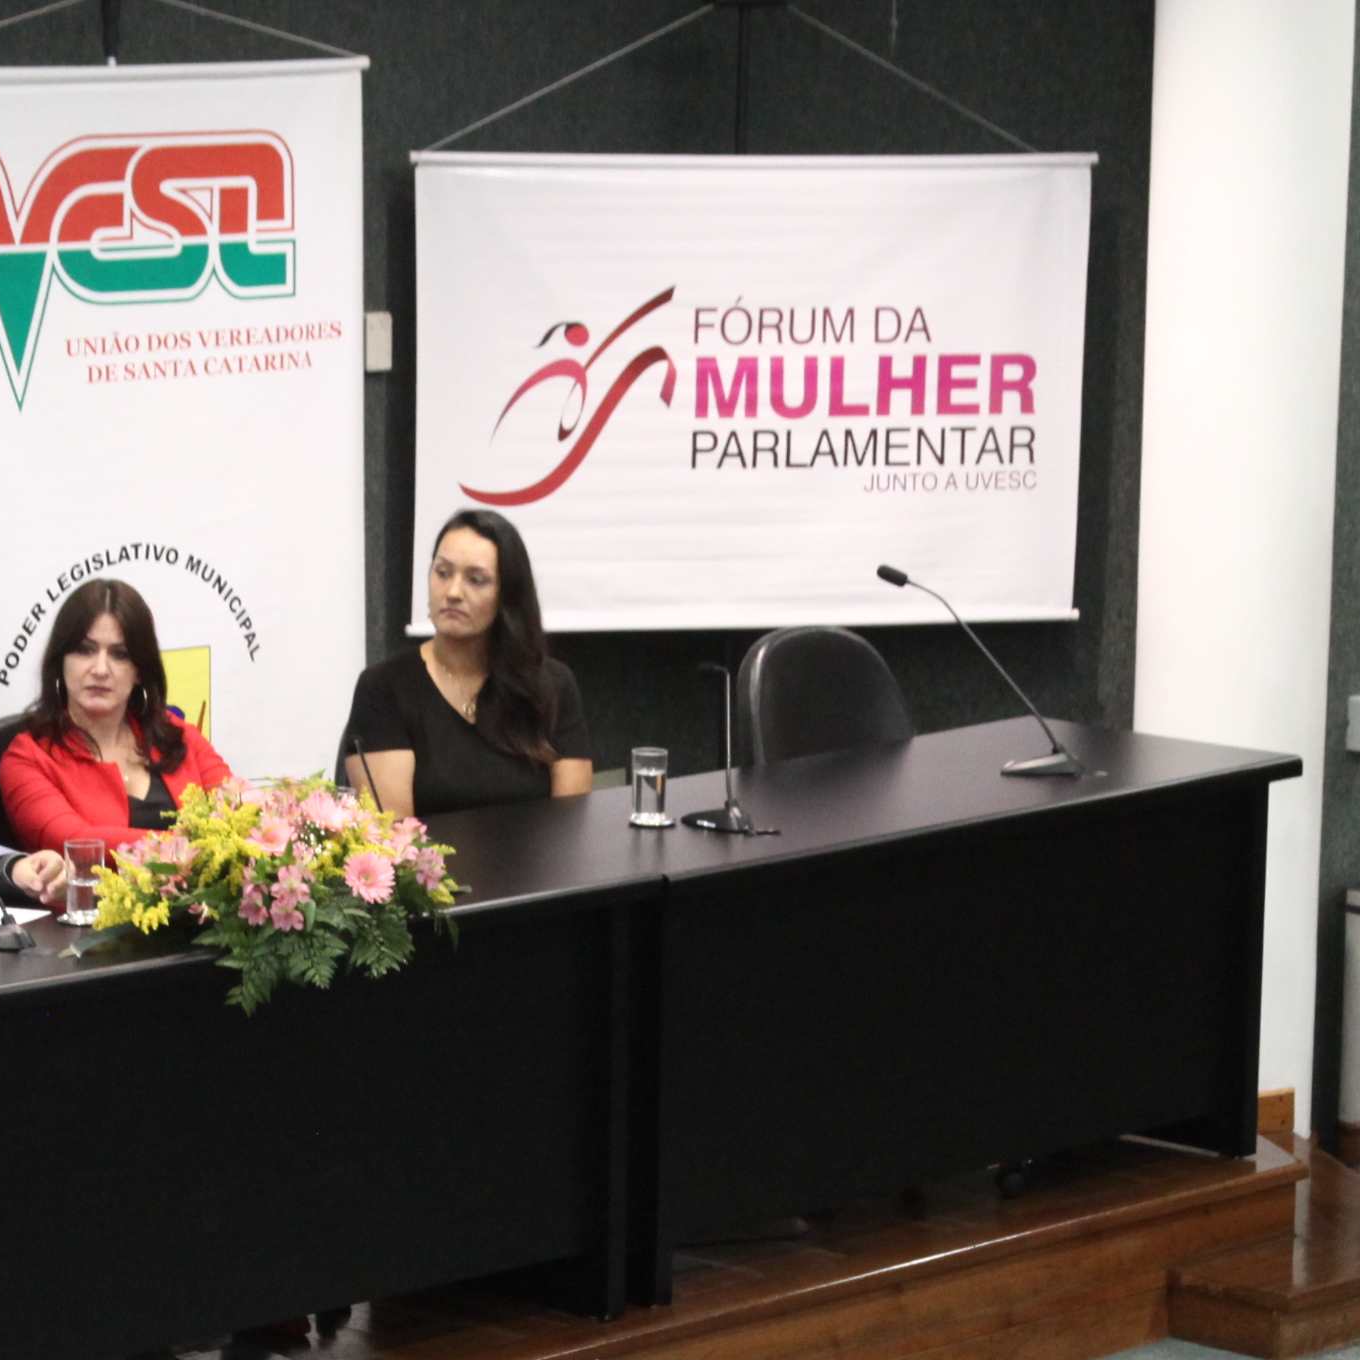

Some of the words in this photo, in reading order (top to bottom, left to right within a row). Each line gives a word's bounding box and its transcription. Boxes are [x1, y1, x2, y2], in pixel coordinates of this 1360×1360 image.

[65, 331, 140, 358] UNIÃO
[147, 330, 191, 352] DOS
[197, 320, 343, 349] VEREADORES
[694, 295, 855, 345] FÓRUM
[874, 306, 932, 344] DA
[87, 363, 118, 384] DE
[123, 358, 197, 381] SANTA
[203, 351, 313, 376] CATARINA
[695, 353, 1037, 419] MULHER
[690, 425, 1036, 469] PARLAMENTAR
[864, 471, 938, 492] JUNTO
[944, 472, 958, 492] A
[965, 469, 1037, 491] UVESC
[46, 543, 180, 603] LEGISLATIVO
[185, 554, 260, 662] MUNICIPAL
